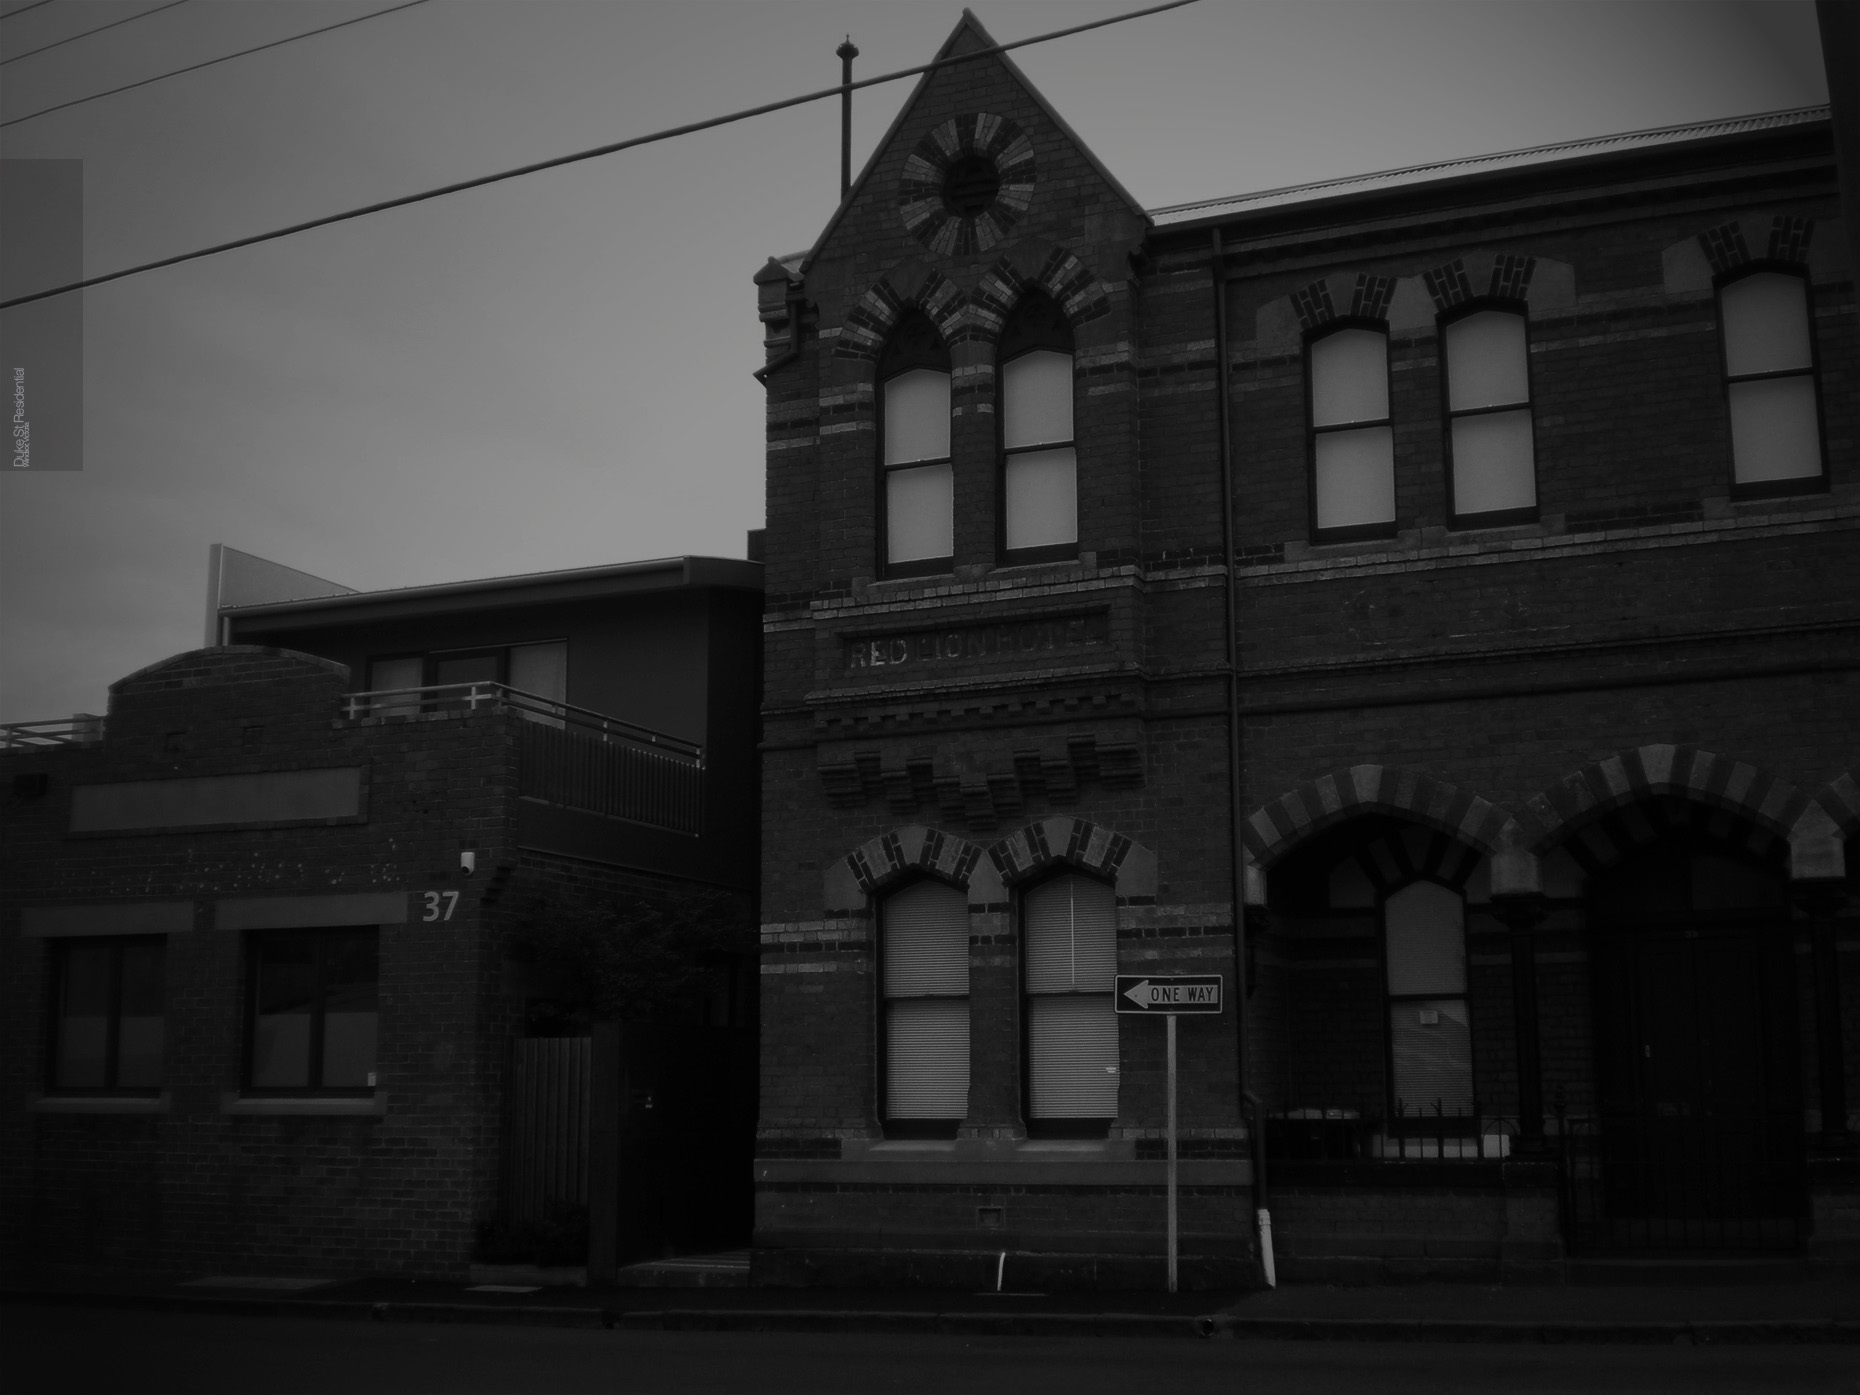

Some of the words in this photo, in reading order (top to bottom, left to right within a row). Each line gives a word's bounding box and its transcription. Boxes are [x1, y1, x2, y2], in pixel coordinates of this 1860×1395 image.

[850, 638, 907, 668] RED
[916, 629, 987, 662] LION
[422, 891, 459, 922] 37
[1151, 987, 1179, 1002] ONE
[1188, 987, 1213, 1002] WAY
